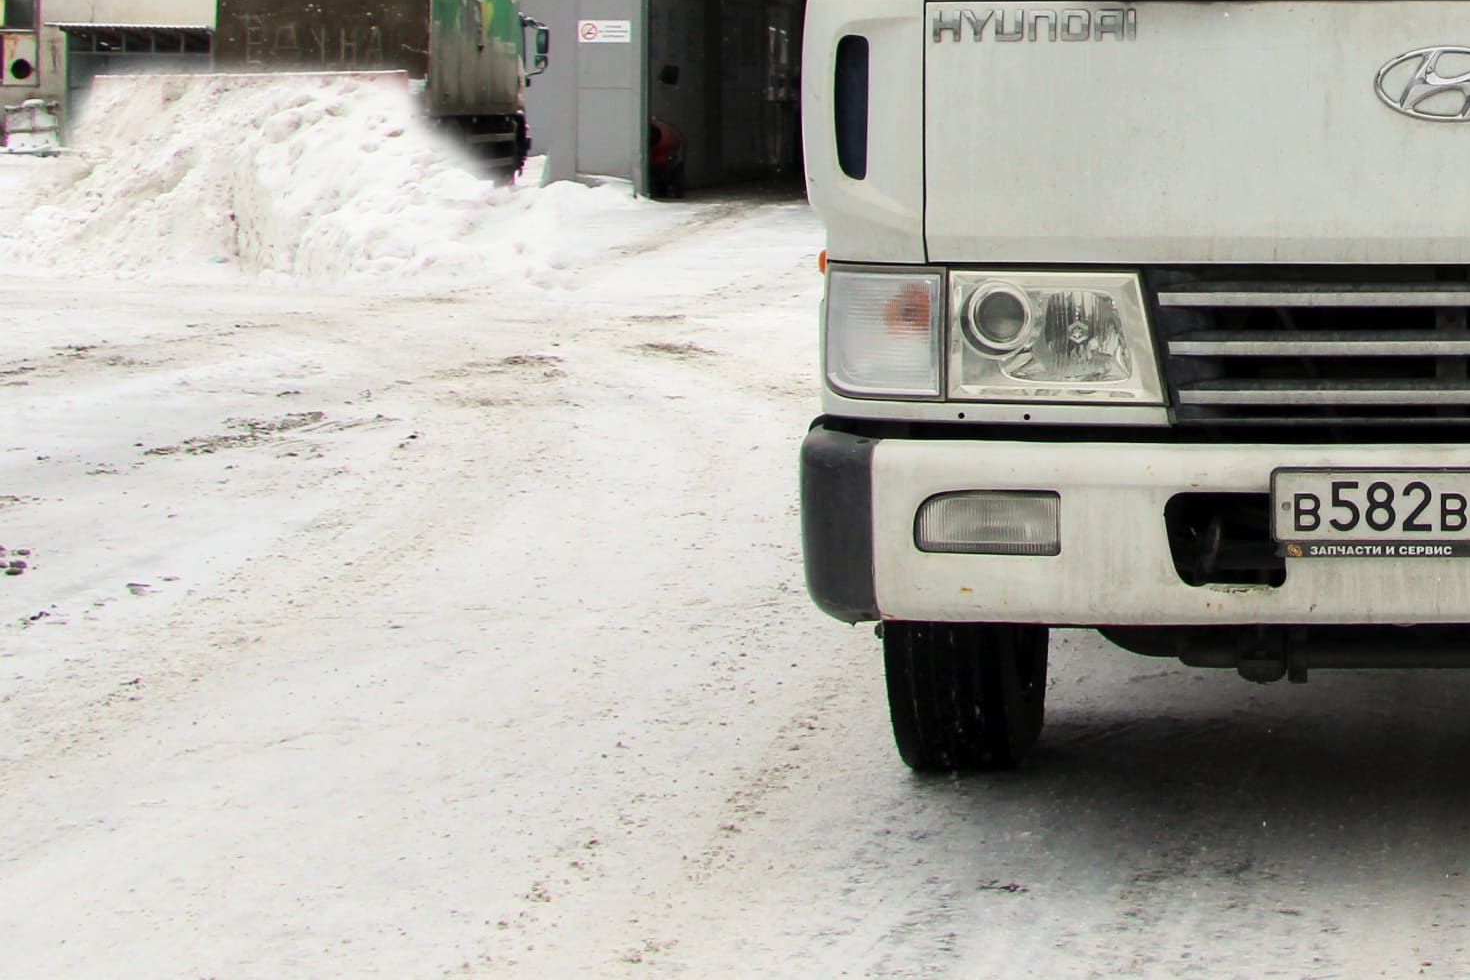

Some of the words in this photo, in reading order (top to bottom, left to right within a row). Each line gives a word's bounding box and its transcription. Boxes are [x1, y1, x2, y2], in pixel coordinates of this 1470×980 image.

[932, 8, 1137, 42] HYUNDAI
[1310, 545, 1382, 556] ЗАПЧАСТИ
[1385, 545, 1396, 556] И
[1399, 545, 1453, 556] СЕРВИС
